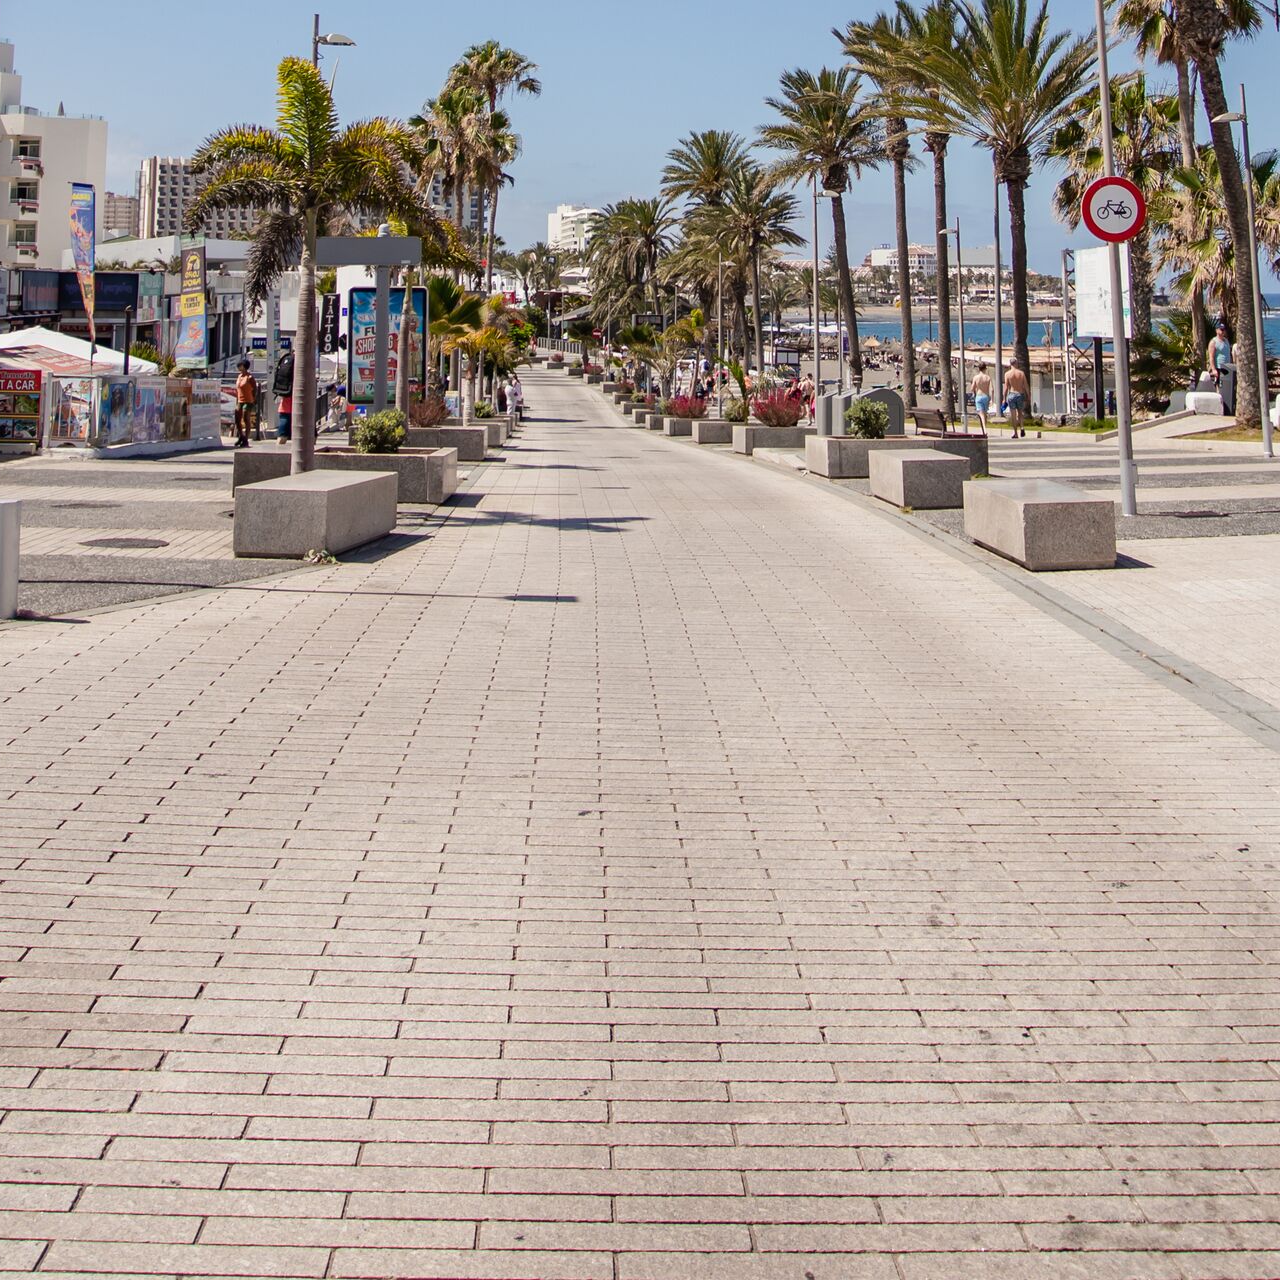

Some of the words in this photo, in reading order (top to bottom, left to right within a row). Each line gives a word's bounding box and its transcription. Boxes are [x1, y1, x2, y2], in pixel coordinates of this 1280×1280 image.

[323, 295, 336, 352] TATTOO
[6, 380, 14, 390] A
[15, 380, 35, 391] CAR
